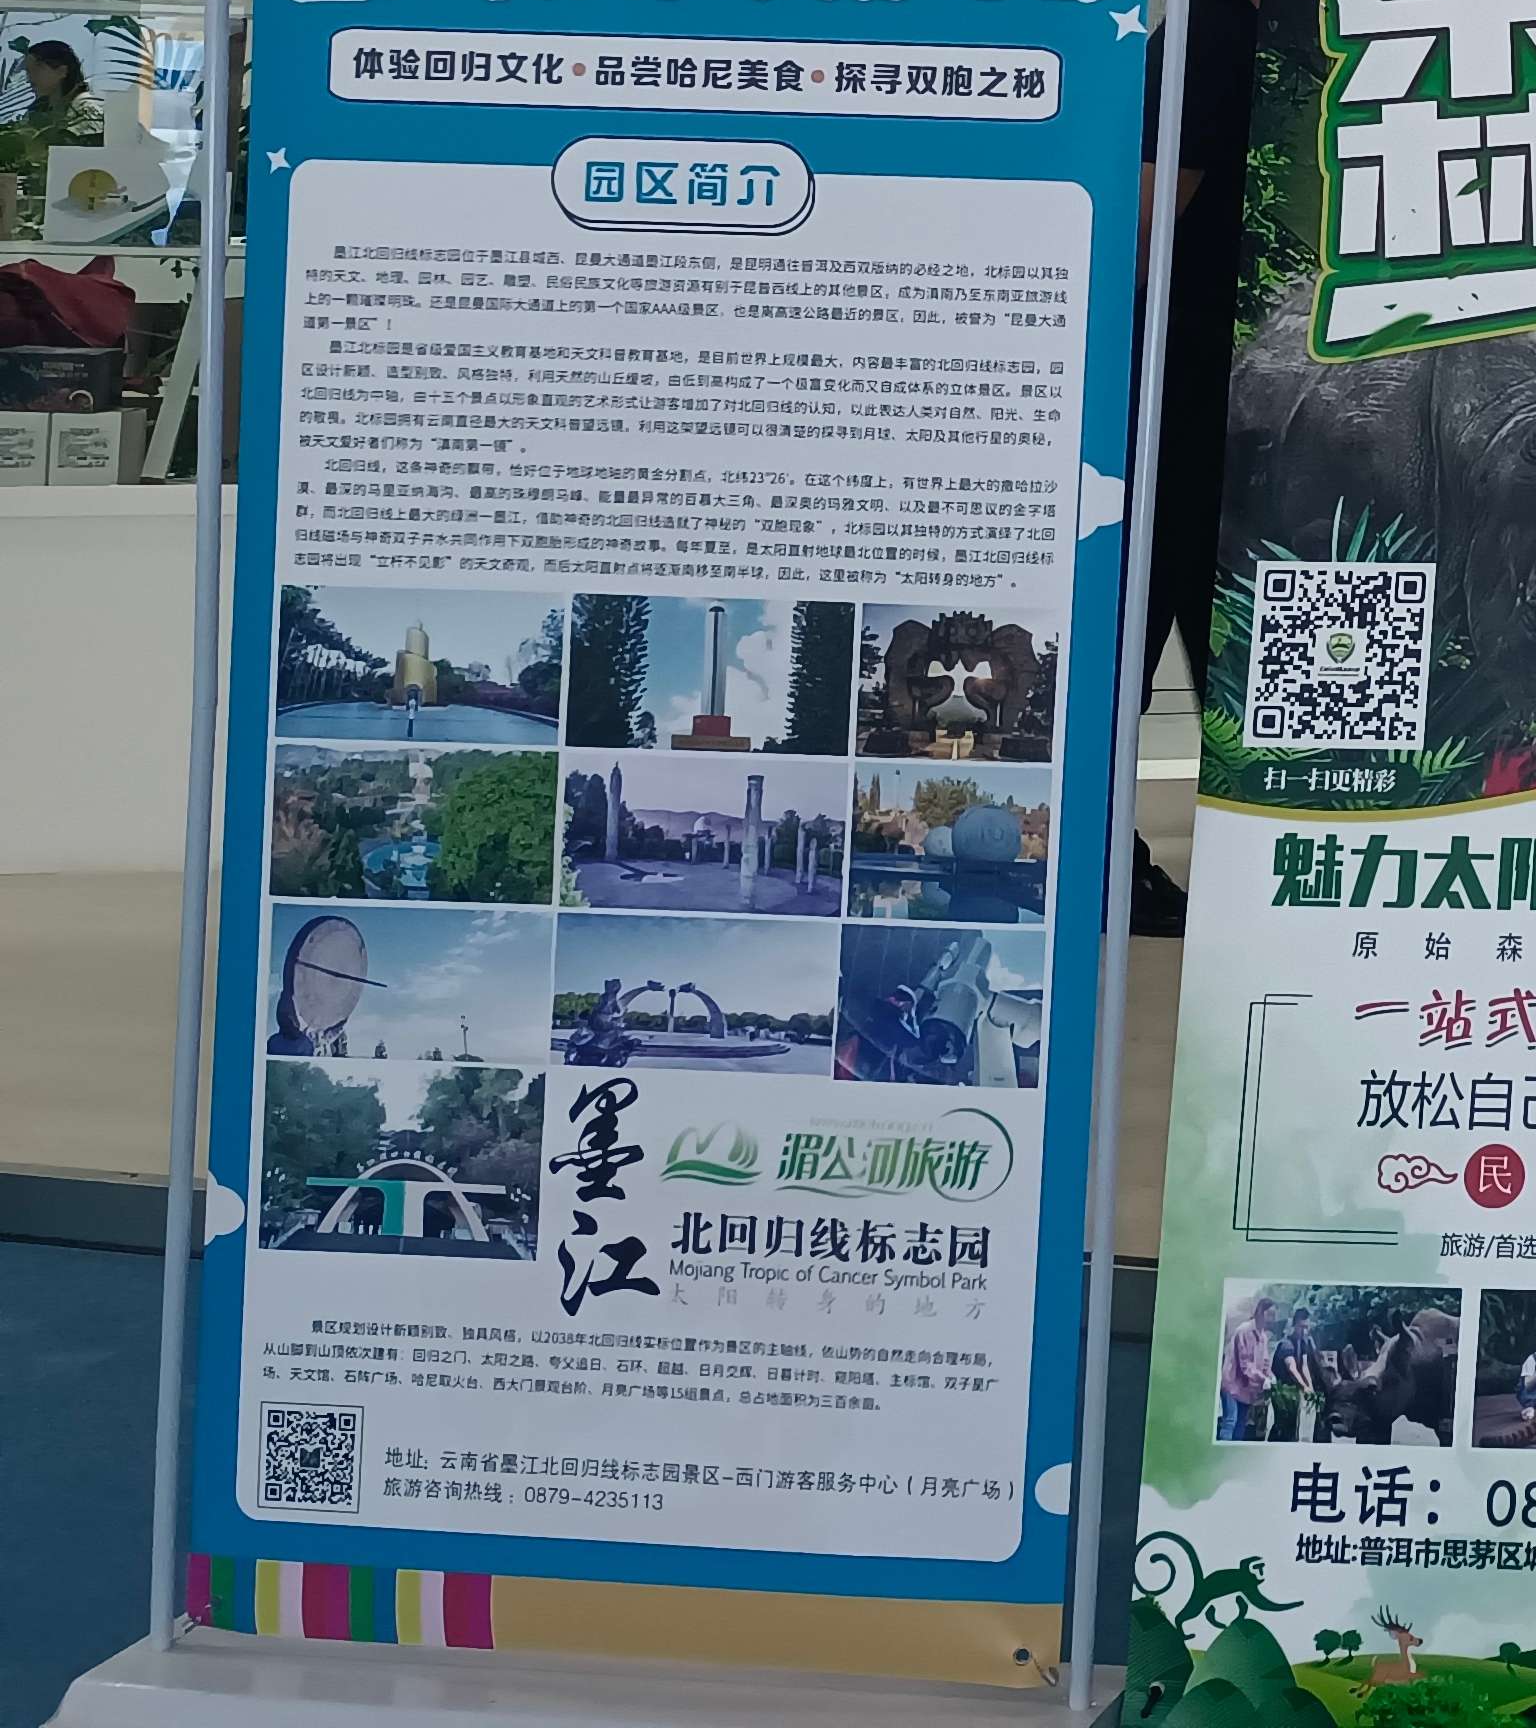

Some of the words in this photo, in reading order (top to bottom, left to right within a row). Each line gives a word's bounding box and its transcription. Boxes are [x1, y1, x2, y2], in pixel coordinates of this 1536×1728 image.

[584, 160, 782, 206] 园区简介
[1264, 766, 1396, 794] 扫一扫更精彩
[777, 1133, 992, 1189] 湄公河旅游
[549, 1078, 660, 1316] 墨江
[672, 1211, 991, 1267] 北回归线标志园
[669, 1258, 734, 1282] Mojiang
[741, 1261, 789, 1284] Tropic
[796, 1264, 814, 1282] of
[818, 1265, 877, 1285] Cancer
[884, 1269, 945, 1291] Symbol
[952, 1271, 986, 1290] Park
